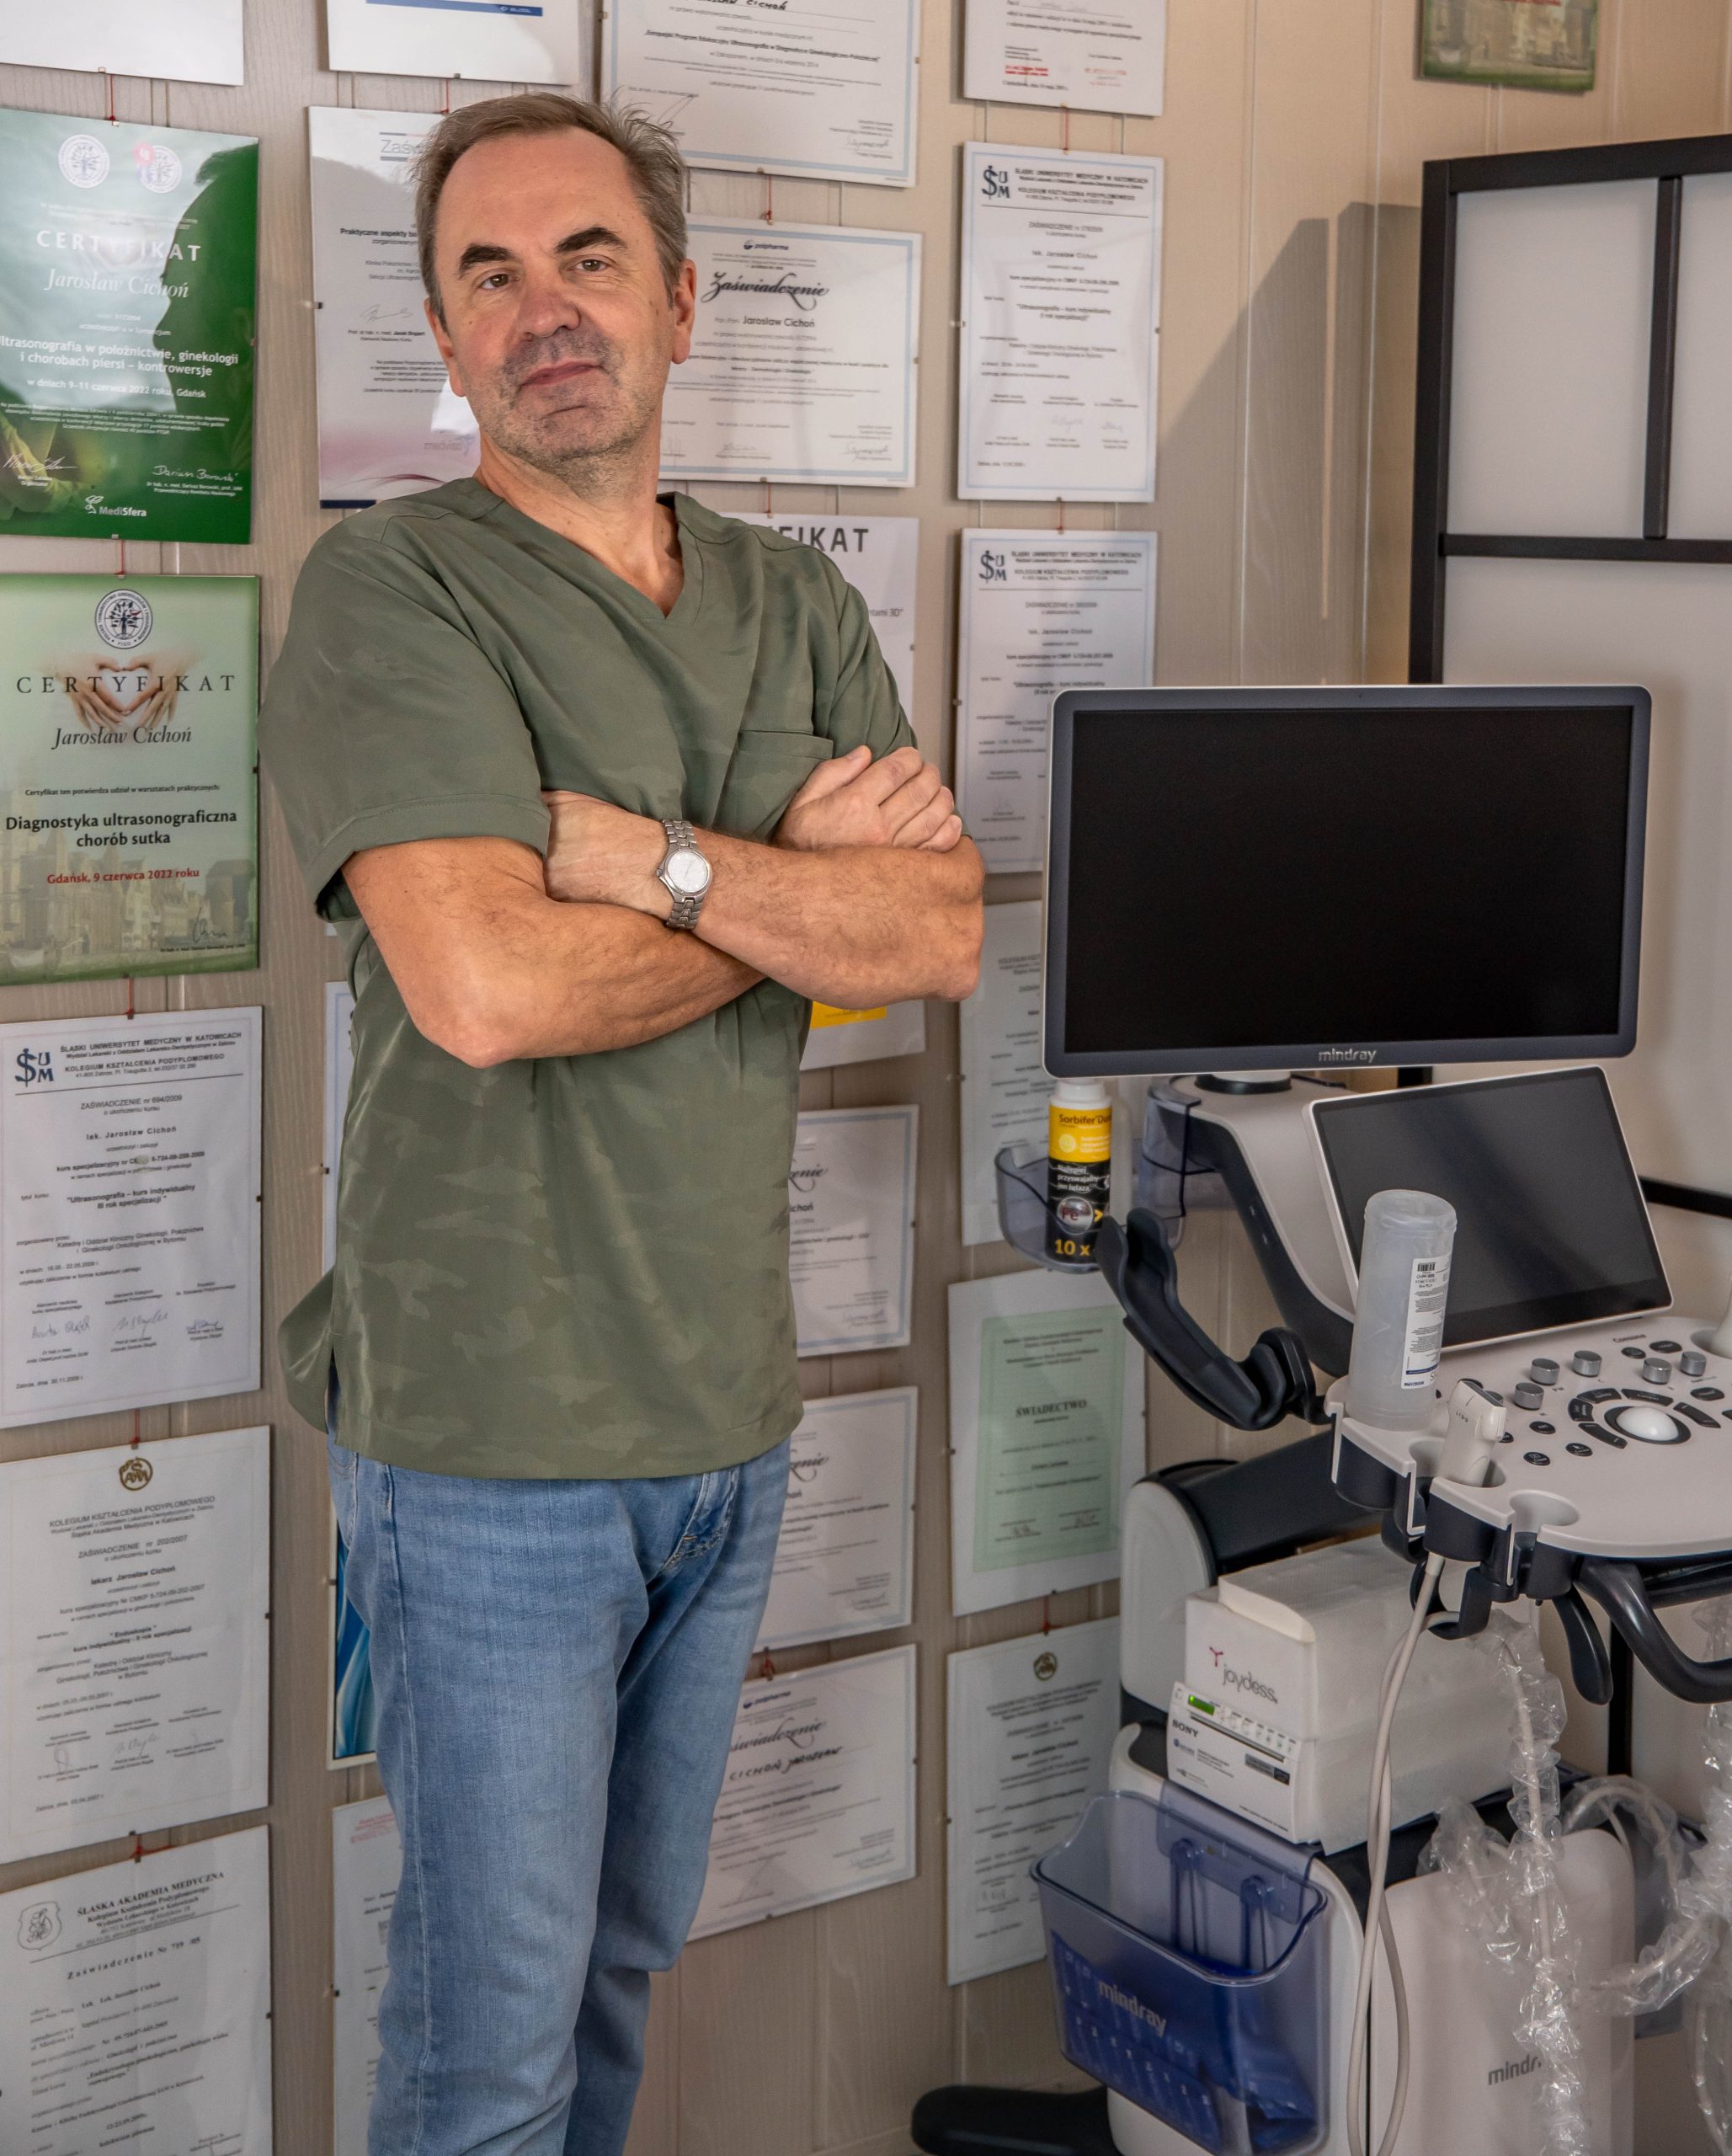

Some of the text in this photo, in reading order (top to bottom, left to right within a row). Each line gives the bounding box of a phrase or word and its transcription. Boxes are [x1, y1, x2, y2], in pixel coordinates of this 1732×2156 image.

[36, 229, 201, 262] CERTYFIKAT
[129, 276, 189, 298] Cichoń
[701, 270, 830, 311] Zaświadczenie
[743, 315, 815, 328] Jarosław Cichoń
[0, 335, 82, 355] ltrasonografia
[179, 350, 239, 366] ginekologii
[20, 352, 24, 362] i
[28, 353, 88, 367] chorobach
[93, 357, 125, 370] piersi
[137, 360, 212, 377] kontrowersje
[37, 378, 66, 389] dniach
[91, 384, 126, 393] czerwca
[128, 385, 150, 394] 2022
[176, 387, 206, 398] Gdańsk
[99, 505, 147, 517] MediSfera
[16, 675, 235, 694] CERTYFIKAT
[51, 723, 192, 750] Jarosław Cichoń
[25, 787, 59, 797] Certyfikat
[72, 787, 109, 797] potwierdza
[110, 785, 130, 794] udział
[138, 785, 175, 793] warsztatach
[6, 809, 237, 832] Diagnostyka ultrasonograficzna
[77, 831, 171, 847] chorób sutka
[47, 867, 200, 884] Gdańsk, 9 czerwca 2022 roku
[89, 1039, 141, 1052] UNIWERSYTET
[143, 1036, 182, 1046] MEDYCZNY
[195, 1032, 242, 1042] KATOWICACH
[64, 1063, 104, 1072] KOLEGIUM
[158, 1053, 225, 1066] PODYPLOMOWEGO
[1319, 1048, 1377, 1063] mindray
[80, 1097, 141, 1110] ZAŚWIADCZENIE
[1058, 1114, 1095, 1125] Sorbifer
[86, 1126, 177, 1141] lek. Jarosław Cichoń
[1054, 1239, 1091, 1256] 10 x
[1016, 1399, 1088, 1418] ŚWIADECTWO
[49, 1515, 90, 1528] KOLEGIUM
[92, 1508, 143, 1521] KSZTAŁCENIA
[144, 1496, 216, 1513] PODYPLOMOWEGO
[78, 1542, 140, 1558] ZAŚWIADCZENIE
[1172, 1718, 1199, 1738] SONY
[118, 1886, 169, 1905] AKADEMIA
[171, 1871, 225, 1890] MEDYCZNA
[1098, 1979, 1167, 2036] mindray
